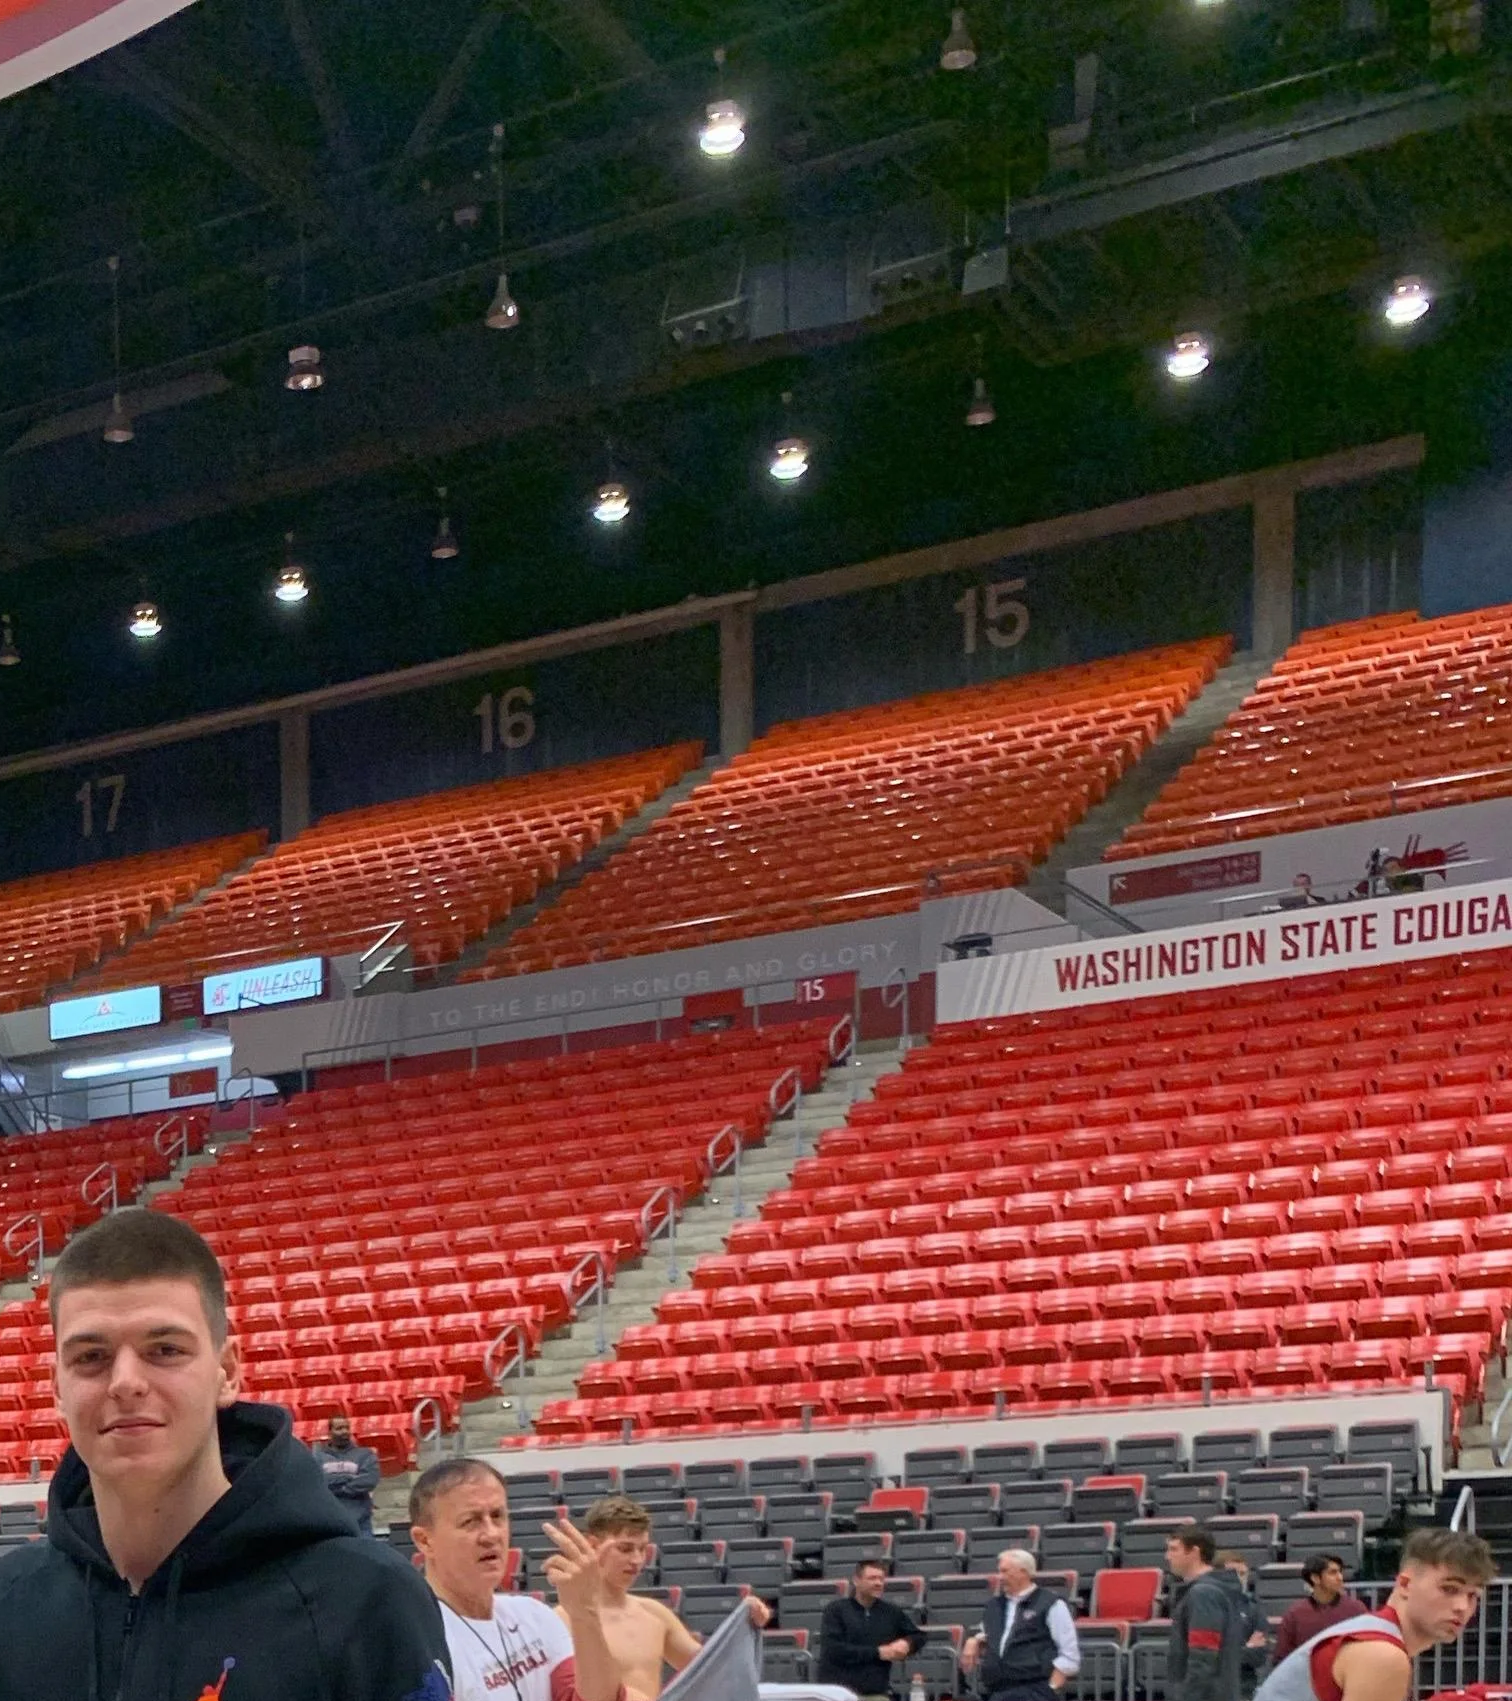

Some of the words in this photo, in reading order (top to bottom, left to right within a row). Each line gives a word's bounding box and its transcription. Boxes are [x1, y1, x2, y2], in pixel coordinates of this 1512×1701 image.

[954, 578, 1030, 654] 15
[472, 686, 536, 753] 16
[75, 774, 125, 837] 17
[243, 968, 314, 1000] UNLEASH
[430, 1008, 462, 1028] TO
[472, 1000, 523, 1022] THE
[726, 958, 784, 983] AND
[799, 941, 897, 972] GLORY
[1055, 928, 1266, 993] WASHINGTON
[1281, 912, 1378, 962] STATE
[802, 978, 825, 1002] 15
